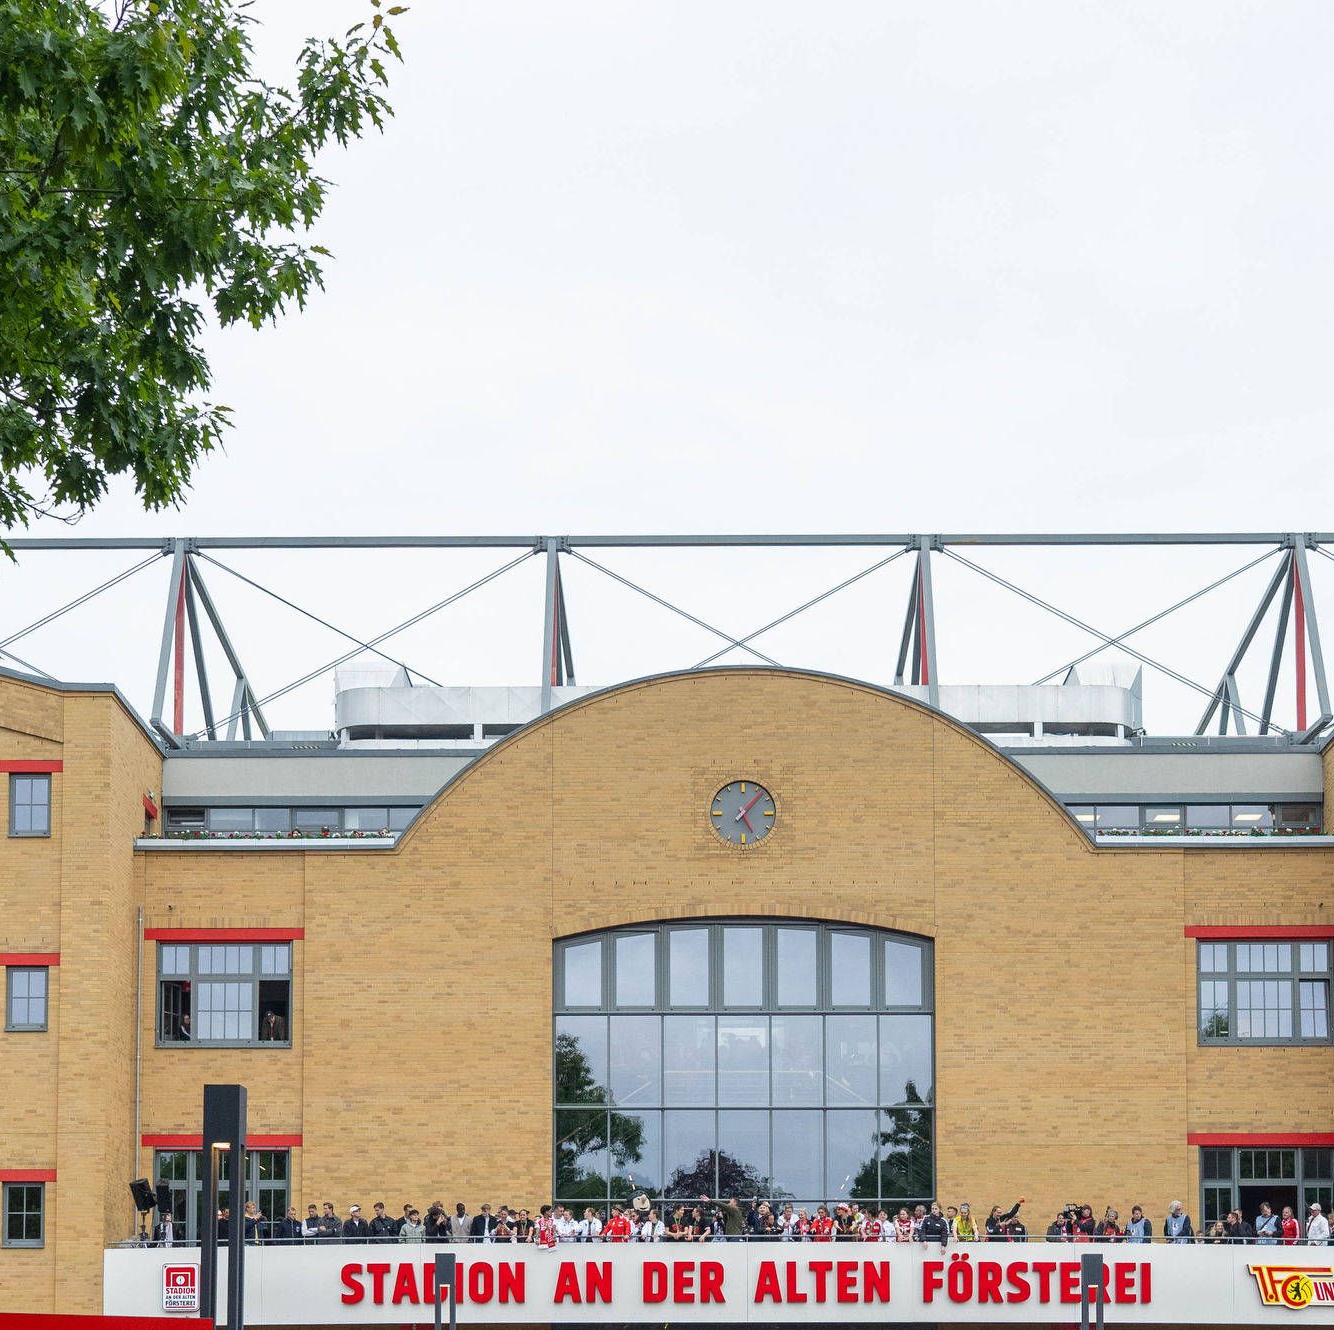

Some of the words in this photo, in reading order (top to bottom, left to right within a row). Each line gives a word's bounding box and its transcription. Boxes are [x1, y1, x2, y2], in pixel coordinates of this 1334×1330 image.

[340, 1262, 526, 1305] STADION
[554, 1262, 612, 1303] AN
[643, 1262, 724, 1303] DER
[755, 1261, 890, 1303] ALTEN
[923, 1253, 1152, 1304] FÖRSTEREI
